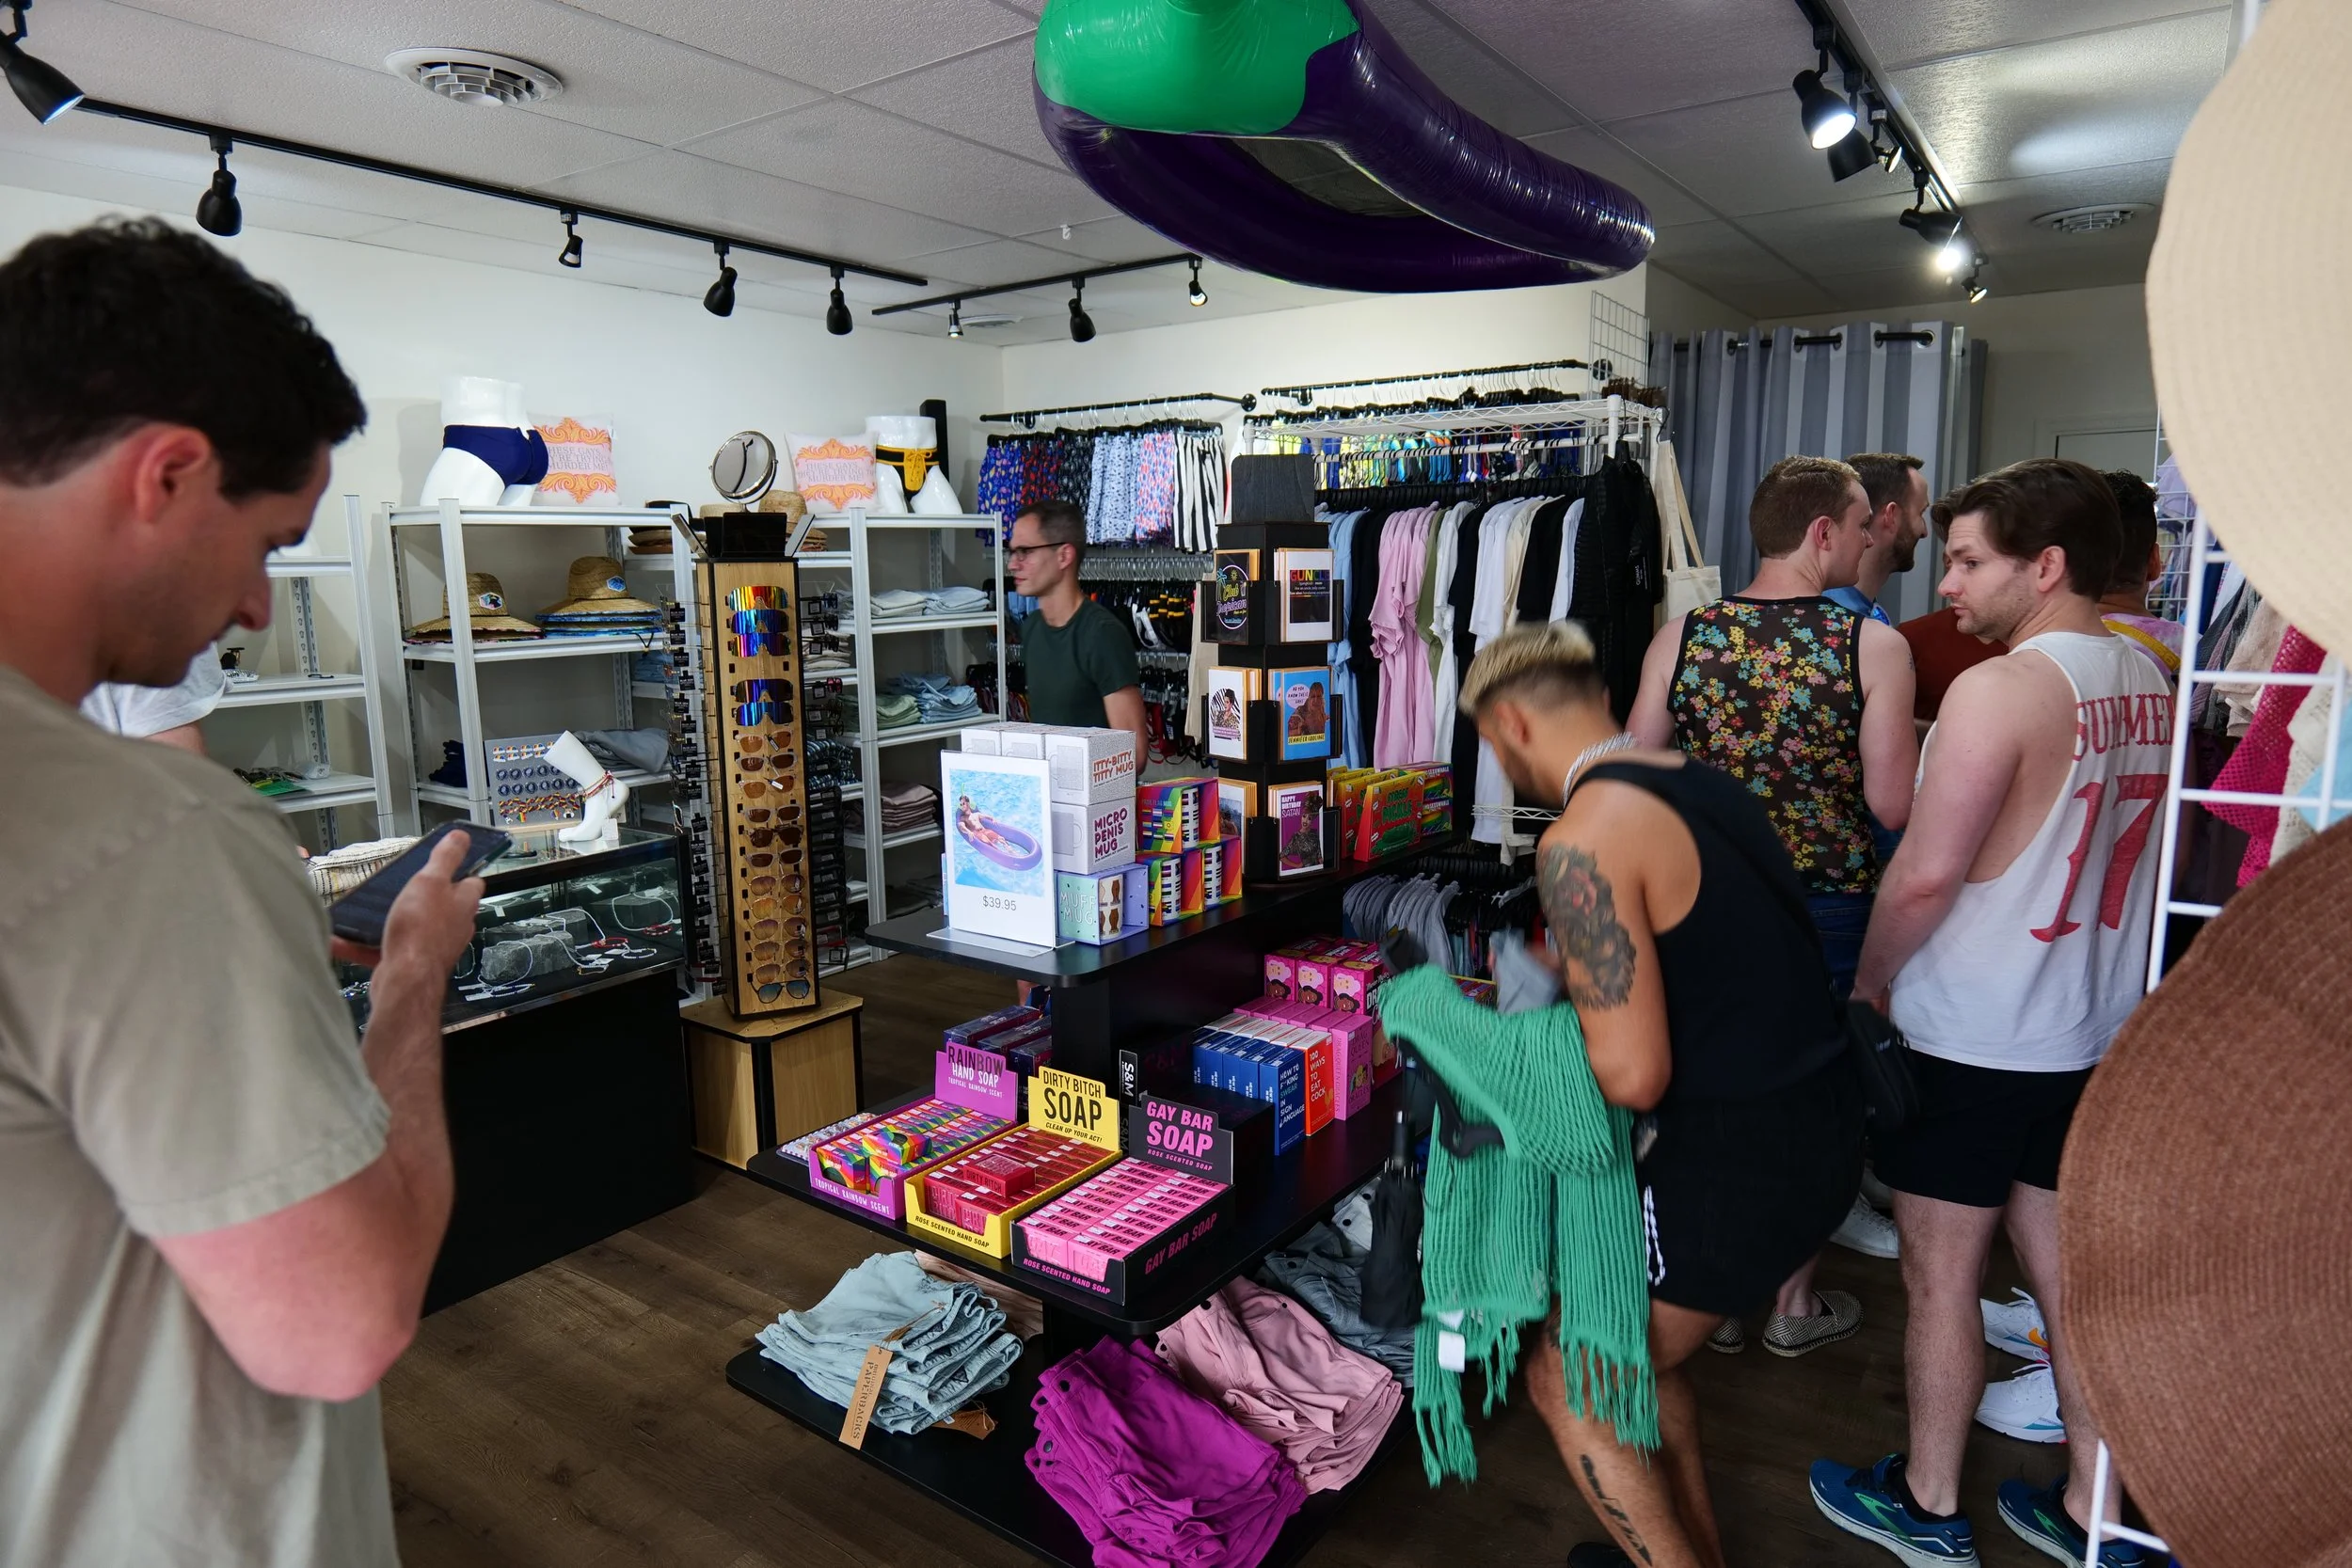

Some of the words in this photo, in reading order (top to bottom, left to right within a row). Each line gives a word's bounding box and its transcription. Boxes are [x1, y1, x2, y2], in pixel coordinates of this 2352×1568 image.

[548, 446, 575, 454] HESE
[1093, 750, 1132, 772] ITTY-BITTY
[1093, 768, 1113, 784] TITTY
[1116, 760, 1134, 776] MUG
[1281, 795, 1295, 803] HAPPY
[1094, 807, 1128, 832] MICRO
[1281, 808, 1301, 818] SATAN
[1094, 822, 1124, 846] PENIS
[1094, 838, 1118, 859] MUG
[2029, 773, 2169, 943] 17
[982, 895, 1016, 911] $39.95
[1060, 891, 1096, 910] MUFF
[1063, 907, 1093, 926] MUG
[948, 1045, 1004, 1078] RAINBOW
[1310, 1050, 1319, 1062] 100
[1310, 1056, 1326, 1071] WAYS
[952, 1062, 975, 1081] HAND
[978, 1070, 998, 1088] SOAP
[1124, 1062, 1135, 1098] S&M
[1279, 1068, 1293, 1081] HOW
[1293, 1063, 1300, 1072] TO
[1310, 1071, 1318, 1082] TO
[948, 1077, 966, 1088] TROPICAL
[968, 1083, 988, 1094] RAINBOW
[989, 1089, 1003, 1099] SCENT
[1043, 1070, 1070, 1090] DIRTY
[1073, 1078, 1101, 1099] BITCH
[1279, 1083, 1298, 1099] SWEAR
[1311, 1080, 1321, 1092] EAT
[1279, 1099, 1286, 1107] IN
[1311, 1086, 1326, 1102] COCK
[1043, 1087, 1102, 1131] SOAP
[1146, 1101, 1177, 1122] GAY
[1180, 1109, 1214, 1132] BAR
[1279, 1103, 1293, 1117] SIGN
[1281, 1104, 1305, 1125] LANGUAGE
[1045, 1122, 1064, 1132] CLEAN
[1073, 1129, 1089, 1139] YOUR
[1089, 1134, 1103, 1143] ACT!
[1146, 1120, 1214, 1158] SOAP
[1147, 1148, 1164, 1159] ROSE
[1166, 1153, 1194, 1166] SCENTED
[1196, 1162, 1213, 1171] SOAP
[965, 1169, 984, 1185] DIRTY
[984, 1177, 1002, 1193] BITCH
[815, 1178, 839, 1196] TROPICAL
[842, 1190, 867, 1207] RAINBOW
[870, 1200, 890, 1215] SCENT
[1094, 1196, 1115, 1205] BAR
[1168, 1199, 1189, 1209] BAR
[1178, 1193, 1200, 1201] BAR
[1071, 1212, 1091, 1221] BAR
[1083, 1205, 1104, 1213] BAR
[1146, 1213, 1168, 1222] BAR
[1157, 1207, 1178, 1215] BAR
[915, 1215, 929, 1226] ROSE
[930, 1221, 956, 1236] SCENTED
[956, 1231, 973, 1243] HAND
[974, 1238, 990, 1248] SOAP
[1045, 1227, 1068, 1236] BAR
[1058, 1219, 1080, 1227] BAR
[1136, 1221, 1157, 1230] BAR
[1111, 1236, 1134, 1245] BAR
[1122, 1228, 1145, 1238] BAR
[1098, 1244, 1120, 1255] BAR
[1144, 1247, 1166, 1275] GAY
[1168, 1231, 1189, 1259] BAR
[1191, 1212, 1217, 1242] SOAP
[1023, 1258, 1041, 1270] ROSE
[1041, 1265, 1071, 1280] SCENTED
[1072, 1275, 1091, 1289] HAND
[1091, 1283, 1111, 1294] SOAP
[852, 1361, 874, 1439] PAPERBACKS
